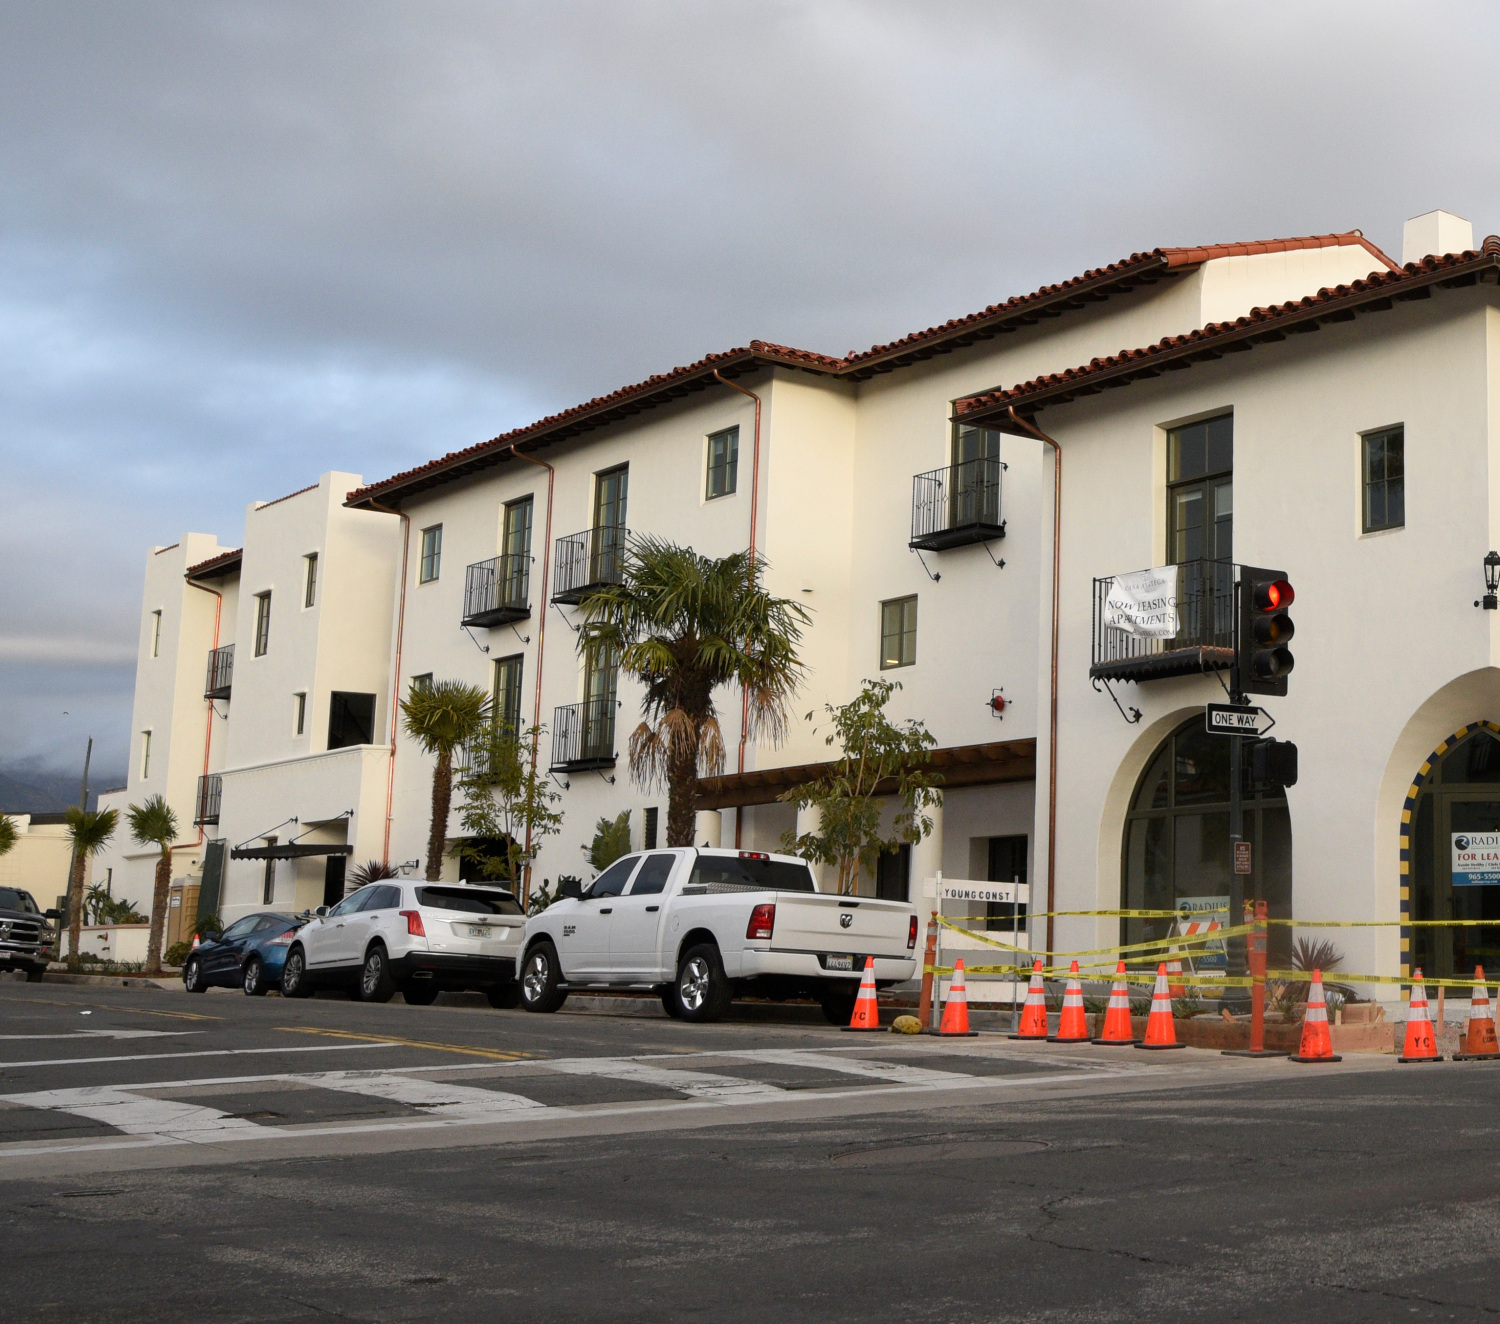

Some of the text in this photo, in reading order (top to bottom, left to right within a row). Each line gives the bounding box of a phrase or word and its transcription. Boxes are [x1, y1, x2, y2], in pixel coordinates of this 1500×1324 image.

[1107, 597, 1177, 612] NOW LEASING
[1109, 613, 1174, 625] APARTMENTS
[1215, 713, 1256, 727] ONE WAY
[1457, 853, 1477, 861] FOR
